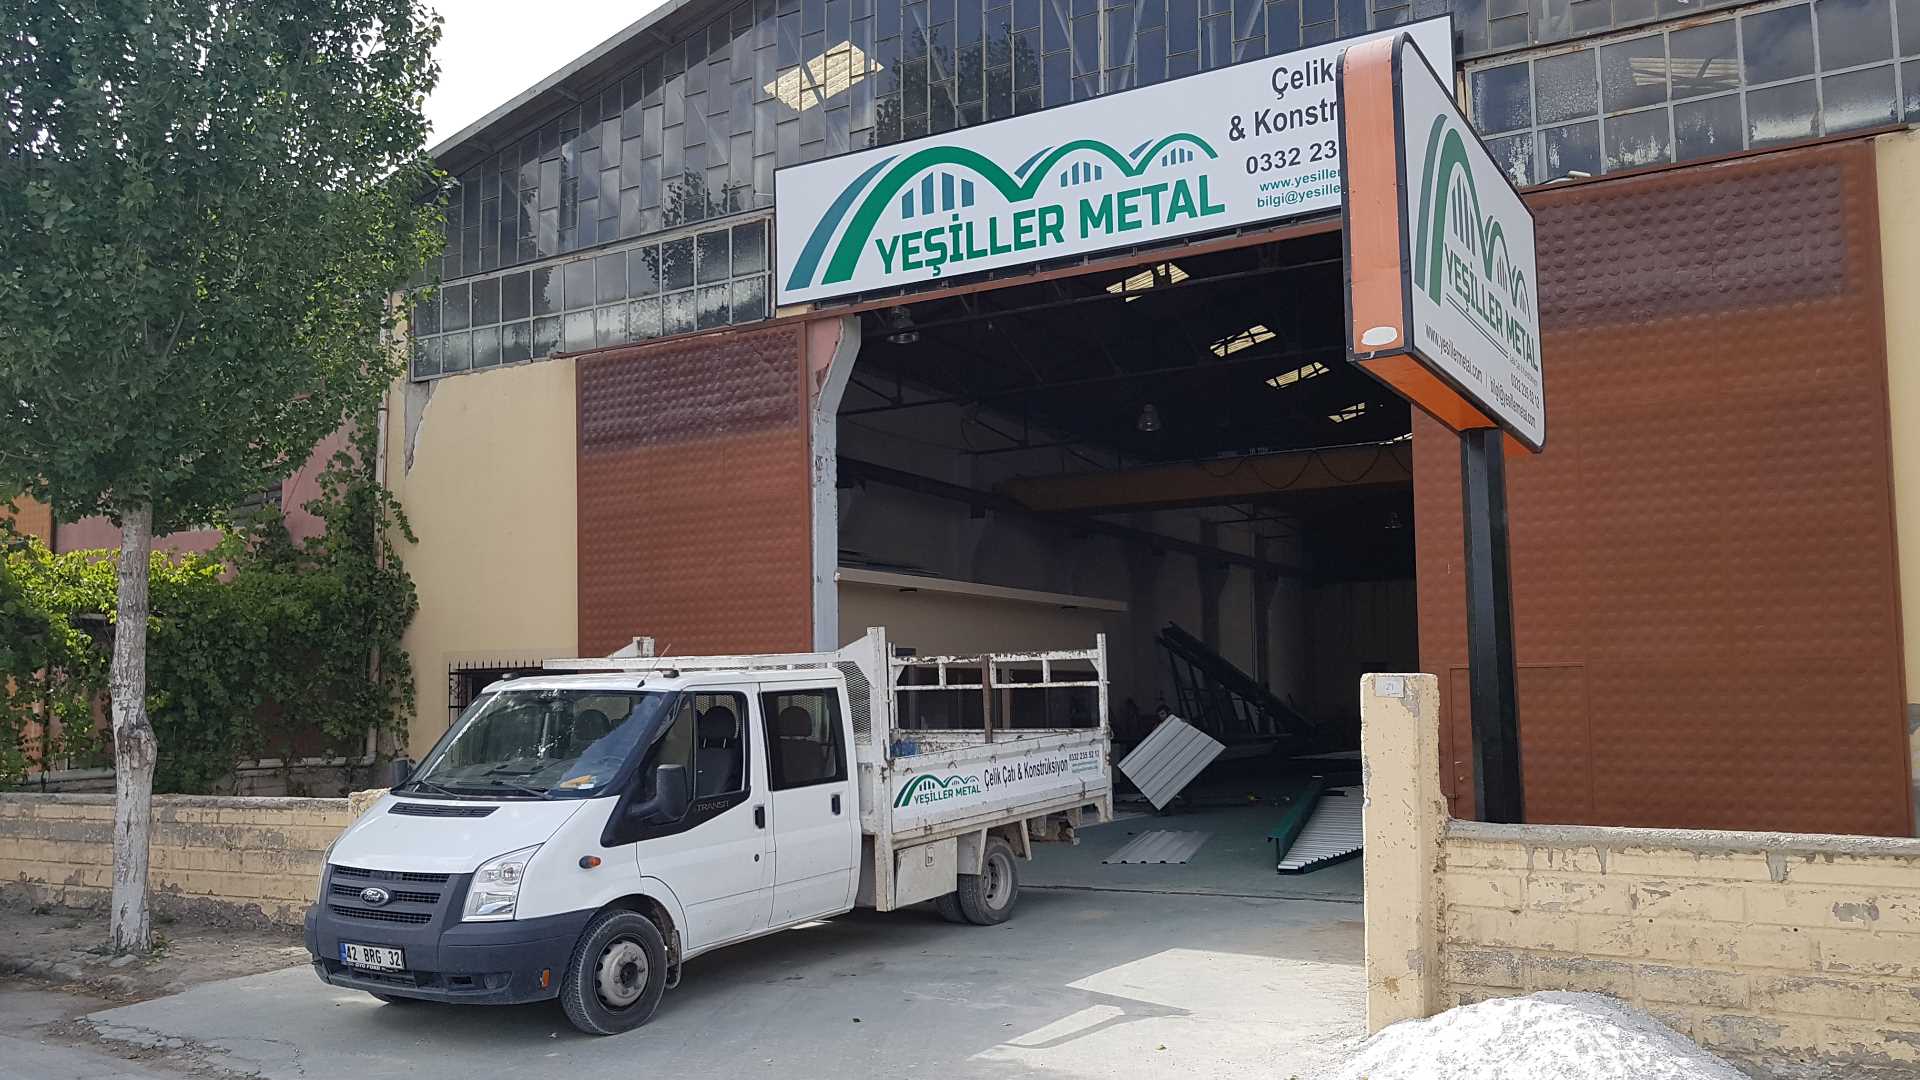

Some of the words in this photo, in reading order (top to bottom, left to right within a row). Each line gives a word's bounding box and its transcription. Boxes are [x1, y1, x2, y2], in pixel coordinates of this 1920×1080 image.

[1271, 57, 1335, 100] Çelik
[1229, 115, 1246, 142] &
[1246, 147, 1301, 174] 0332
[1309, 139, 1337, 162] 23
[875, 204, 1065, 276] YEŞİLLER
[1079, 174, 1226, 239] METAL
[1444, 241, 1504, 338] YEŞİLLER
[1505, 309, 1539, 372] METAL
[984, 767, 1001, 792] Çelik
[1002, 764, 1016, 789] Çatı
[1017, 762, 1023, 780] &
[1023, 756, 1068, 780] Konstrüksiyon
[914, 789, 954, 805] YEŞİLLER
[955, 784, 981, 797] METAL
[346, 945, 358, 961] 42
[363, 947, 382, 964] BRG
[388, 950, 401, 967] 32
